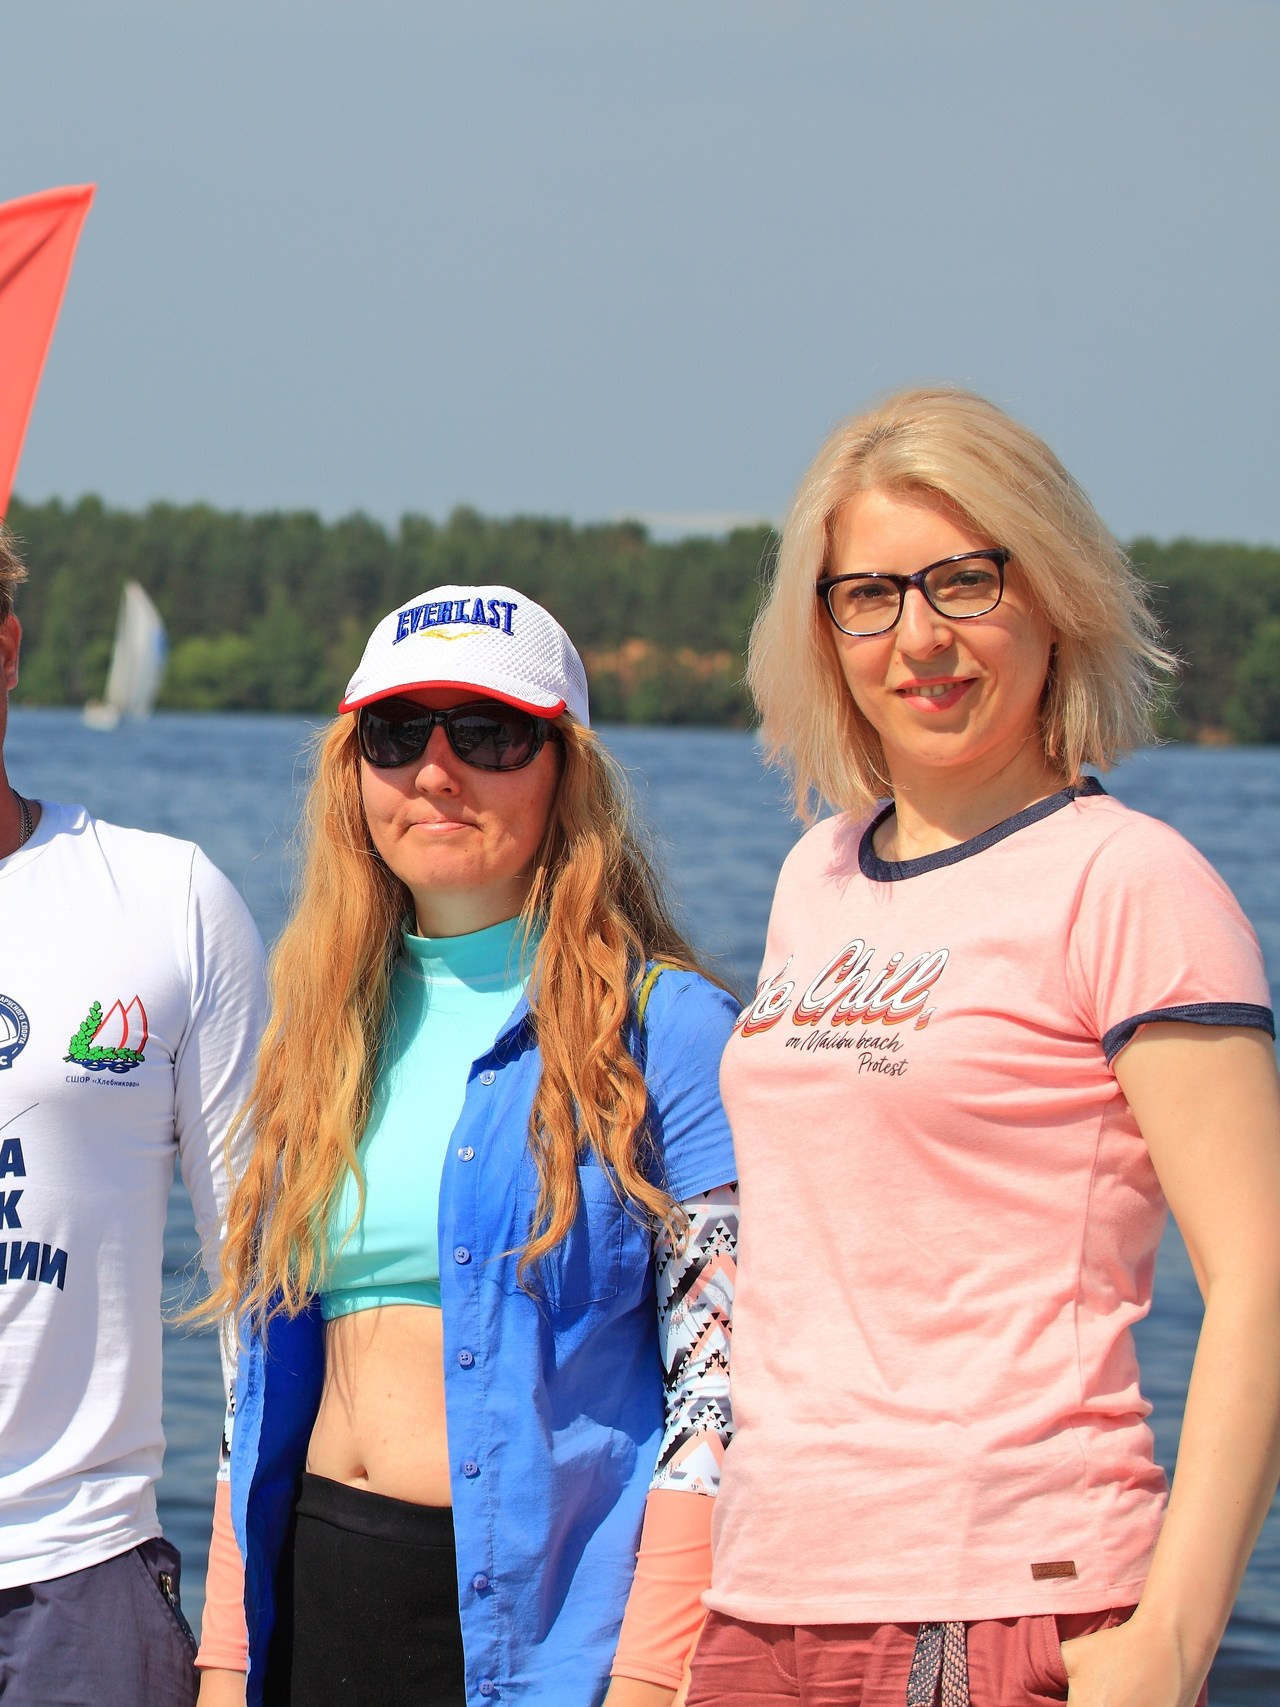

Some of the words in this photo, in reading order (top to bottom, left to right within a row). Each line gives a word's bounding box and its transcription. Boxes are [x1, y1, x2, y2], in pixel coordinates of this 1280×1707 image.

[392, 597, 518, 646] EVERLAST
[17, 1020, 28, 1045] СПОРТА
[785, 1034, 801, 1048] on
[800, 1029, 854, 1053] Malibu
[856, 1029, 904, 1052] beach
[858, 1051, 909, 1077] Protest
[65, 1075, 90, 1083] СШОР
